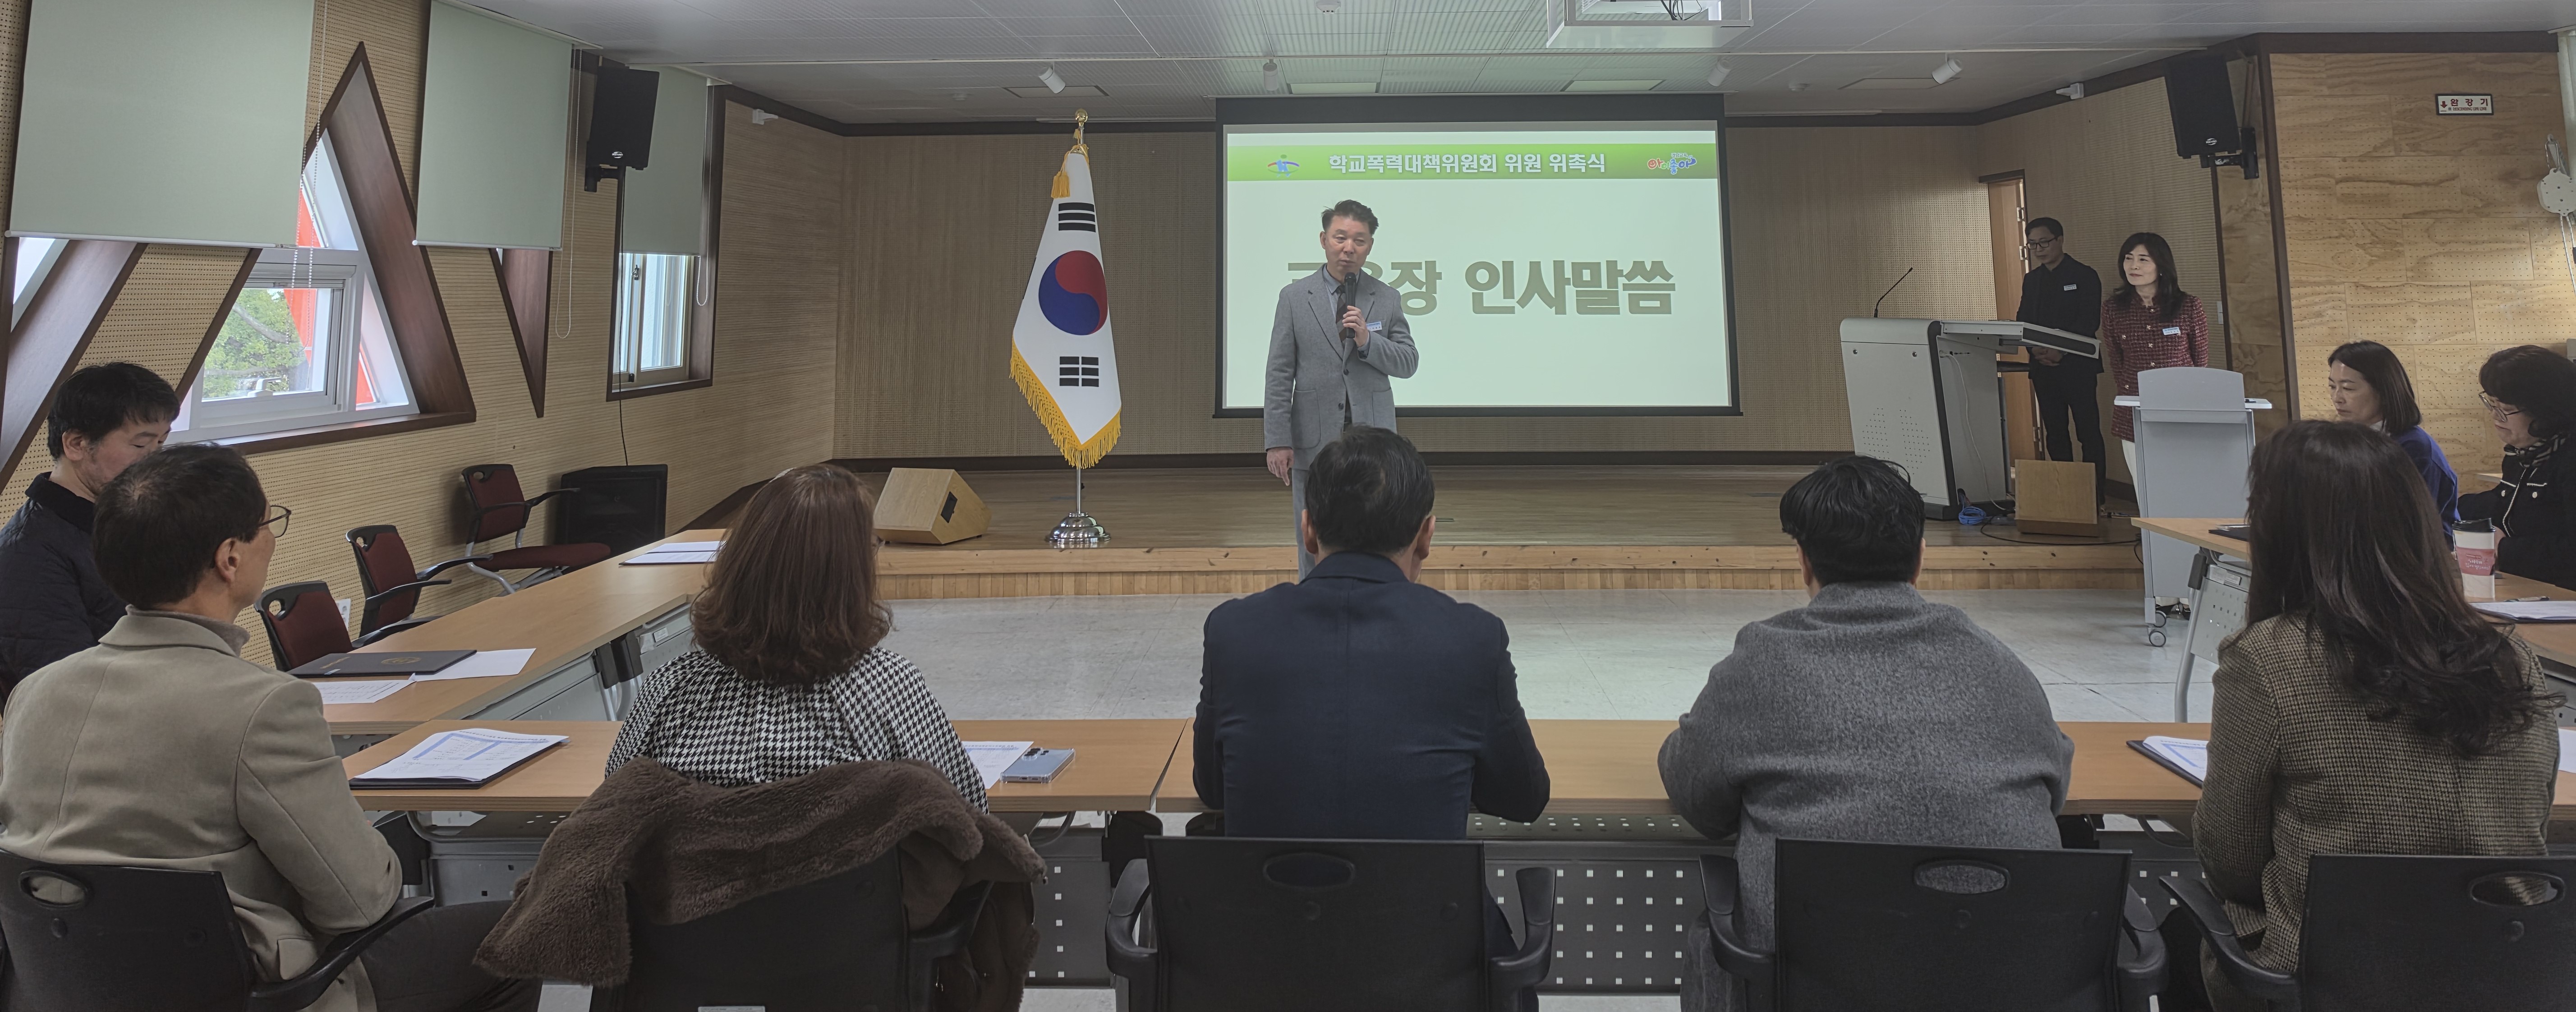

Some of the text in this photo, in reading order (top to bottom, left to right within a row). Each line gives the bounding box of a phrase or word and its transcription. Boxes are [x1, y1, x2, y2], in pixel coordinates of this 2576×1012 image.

[2451, 98, 2488, 106] 완강기
[1329, 154, 1605, 173] 학교폭력대책위원회 위원 위촉식
[1465, 260, 1676, 315] 인사말씀
